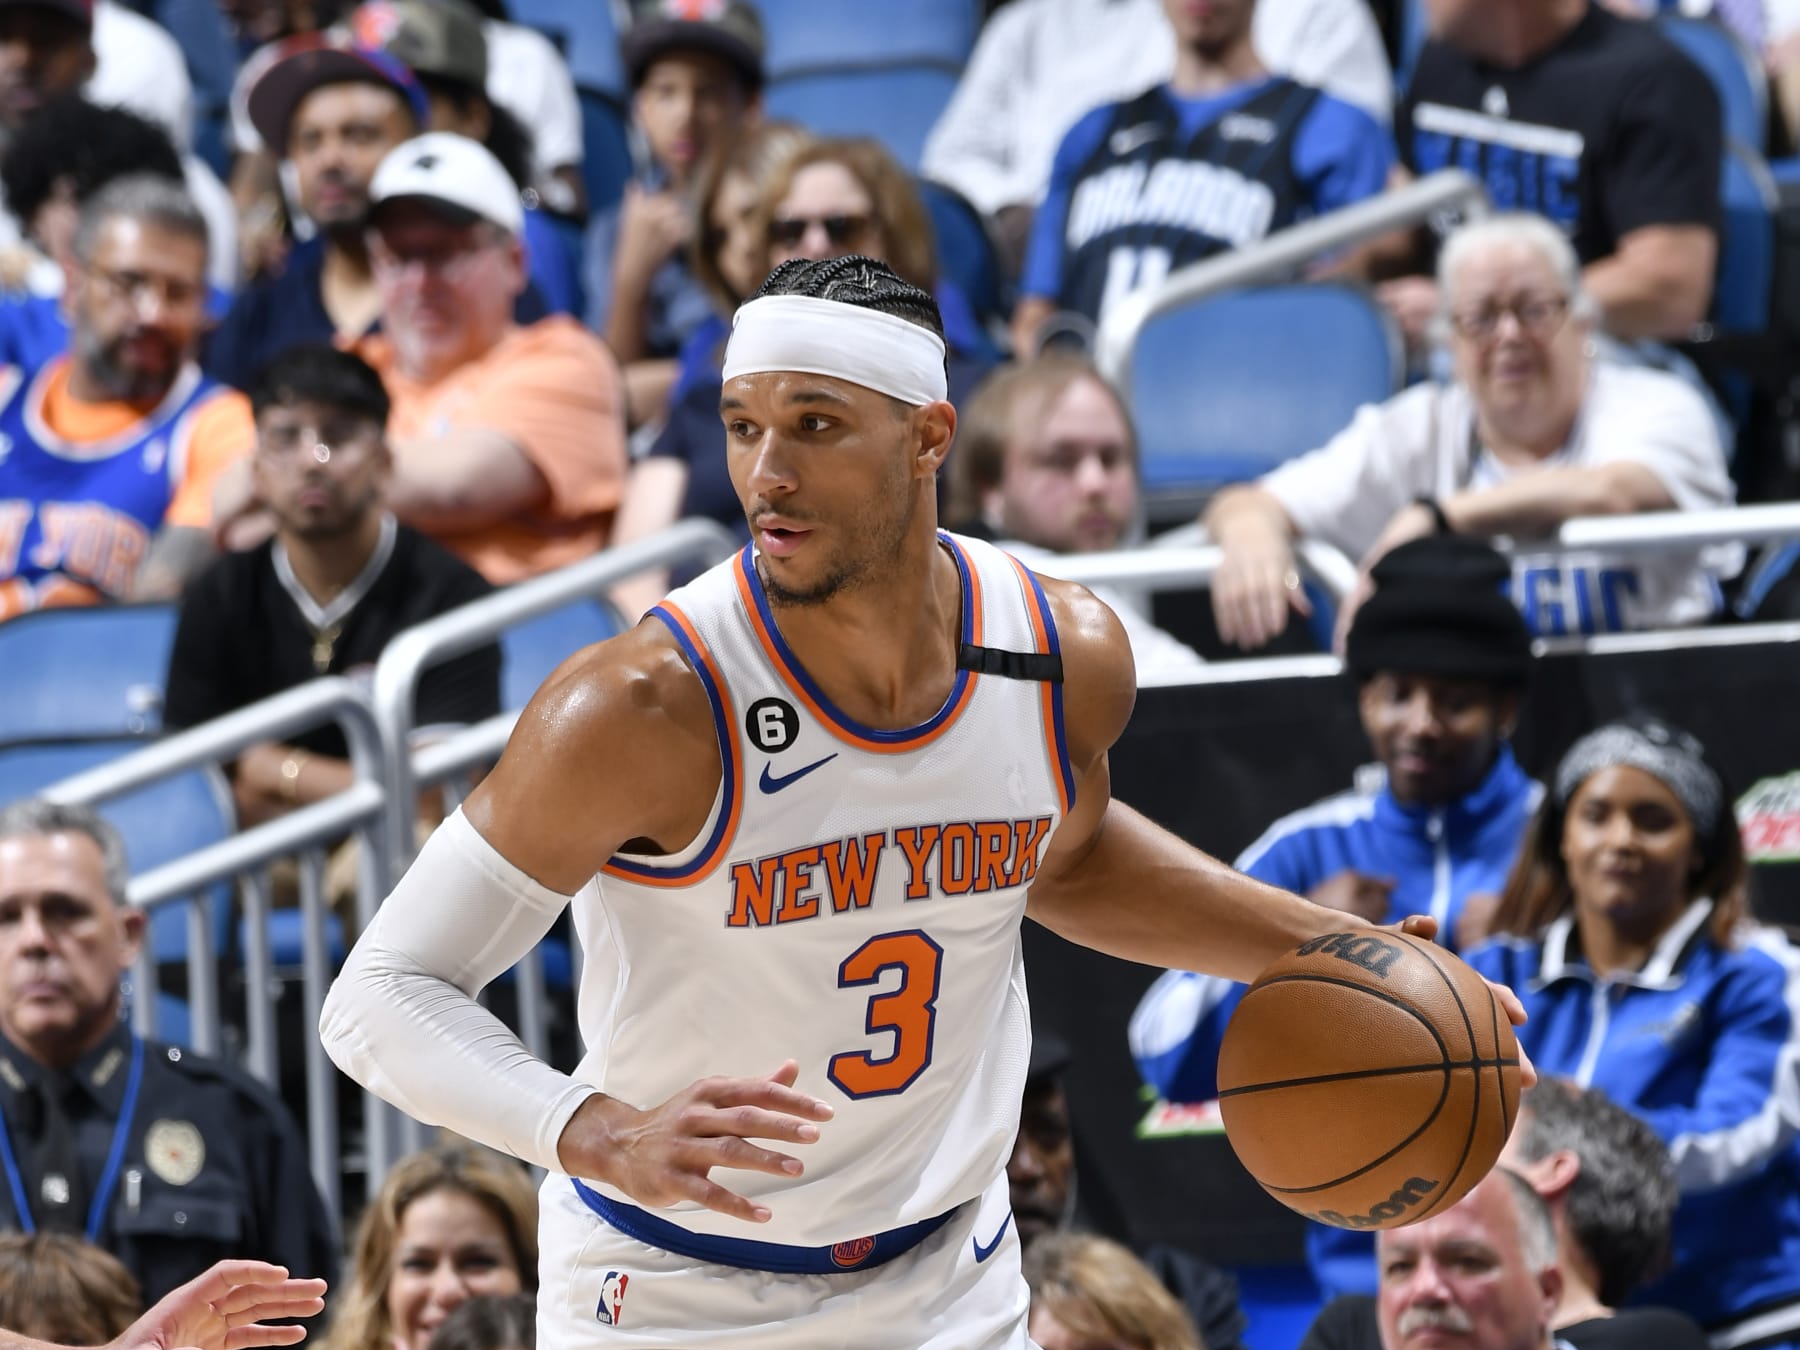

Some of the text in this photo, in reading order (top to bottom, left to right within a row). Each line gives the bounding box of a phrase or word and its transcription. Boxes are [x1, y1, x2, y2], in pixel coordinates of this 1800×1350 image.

[1522, 567, 1640, 636] GIC
[756, 706, 787, 747] 6
[726, 814, 1053, 928] NEW YORK
[827, 928, 945, 1101] 3
